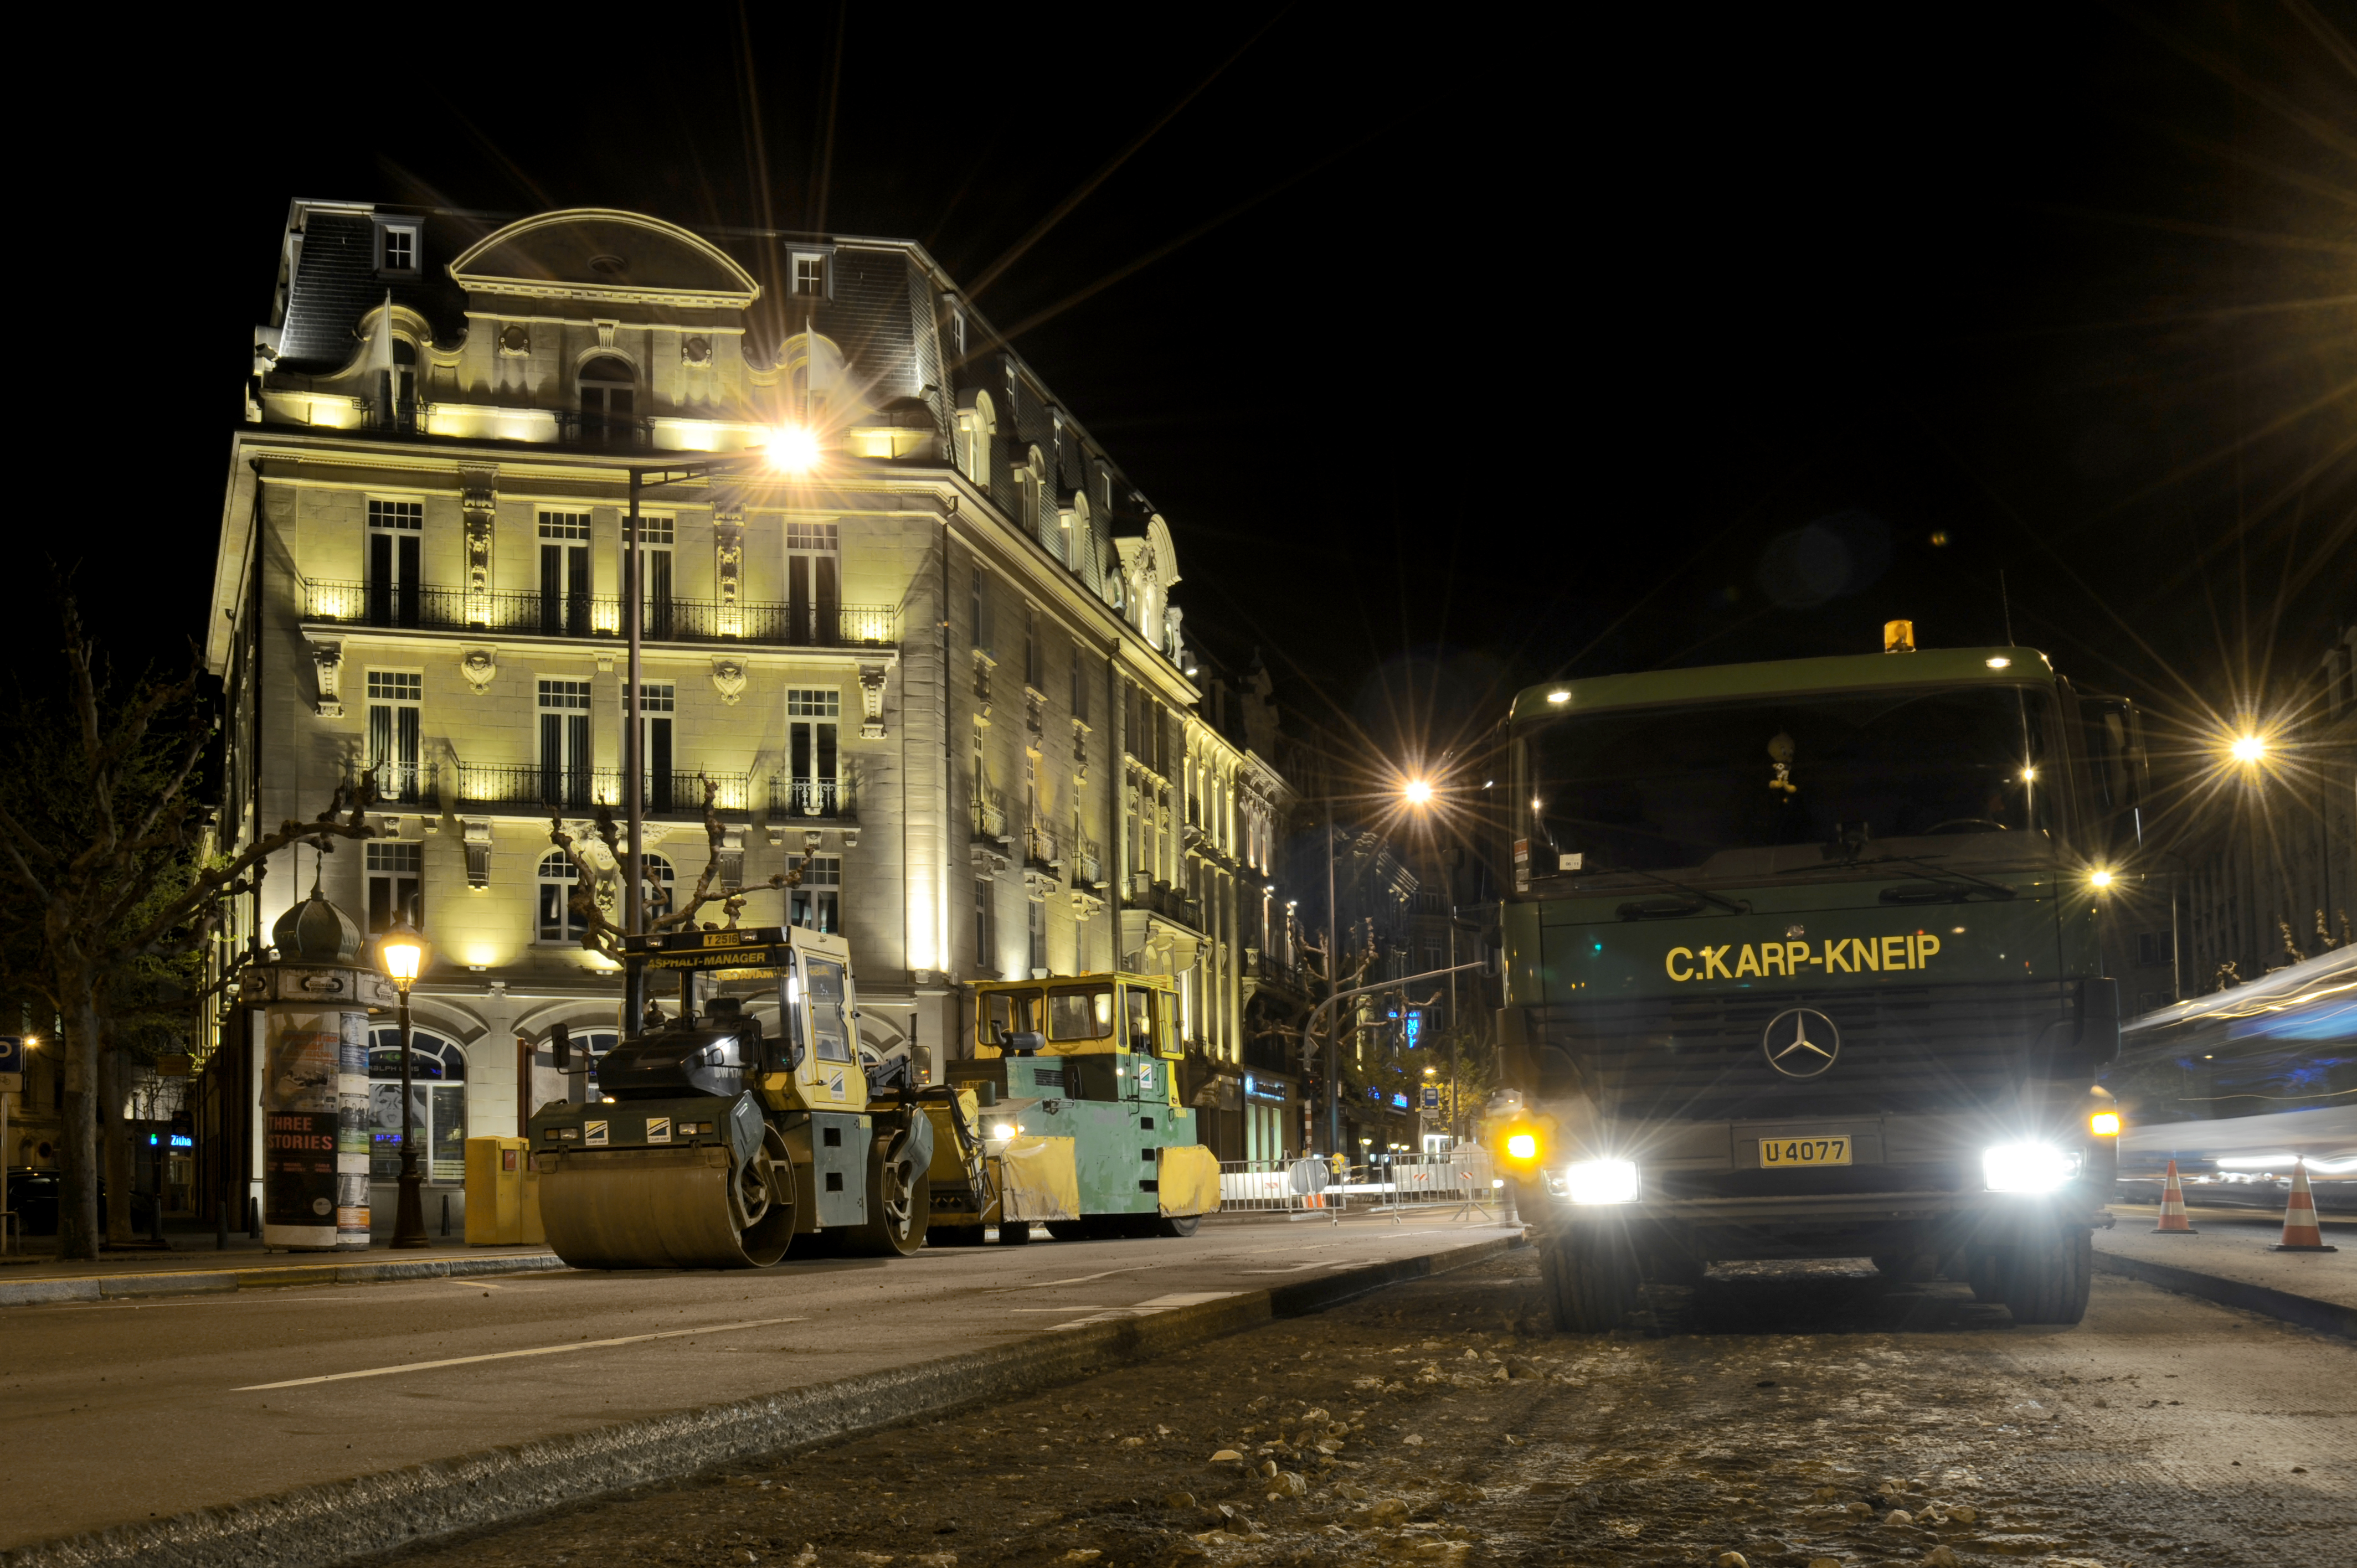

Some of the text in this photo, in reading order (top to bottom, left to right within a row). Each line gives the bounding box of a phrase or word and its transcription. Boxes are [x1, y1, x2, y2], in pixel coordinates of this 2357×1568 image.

[707, 934, 738, 945] Y 2516
[647, 952, 765, 968] ASPHALT-MANAGER
[1666, 935, 1940, 982] C.KARP-KNEIP
[714, 1066, 728, 1078] BW
[268, 1116, 312, 1132] THREE
[171, 1134, 192, 1147] Zitha
[267, 1134, 333, 1150] STORIES
[1766, 1141, 1844, 1162] U 4077
